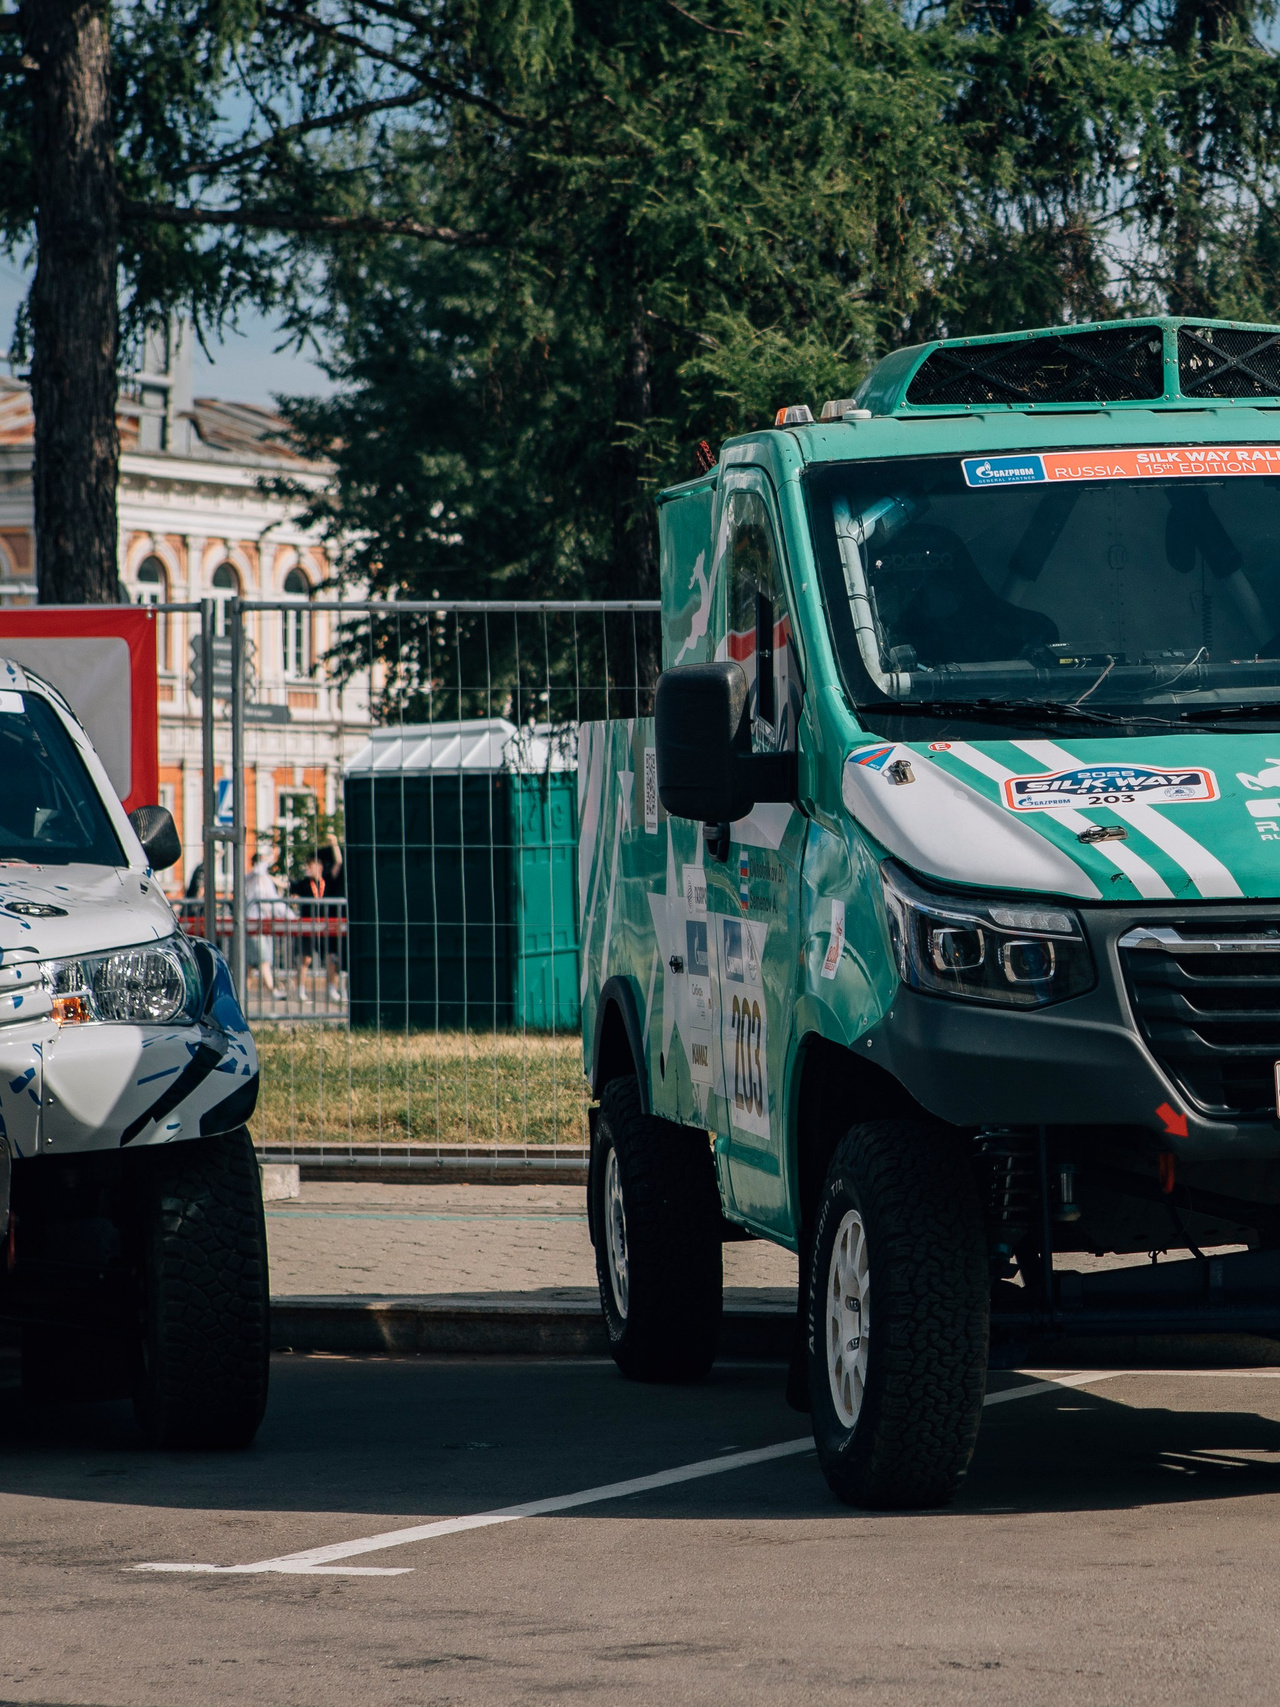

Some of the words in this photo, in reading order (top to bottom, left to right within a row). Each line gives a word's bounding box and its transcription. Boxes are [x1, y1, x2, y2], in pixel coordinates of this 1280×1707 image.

[1136, 453, 1180, 463] SILK
[1183, 451, 1229, 462] WAY
[993, 467, 1034, 477] GAZPROM
[1054, 465, 1127, 477] RUSSIA
[1146, 463, 1174, 475] 15th
[1180, 462, 1257, 474] EDITION
[1078, 770, 1135, 778] 2025
[1025, 778, 1107, 792] SILK
[1115, 774, 1192, 786] WAY
[1077, 785, 1142, 794] RALLY
[1034, 798, 1071, 806] GAZPROM
[1088, 794, 1136, 805] 203
[732, 994, 764, 1118] 203
